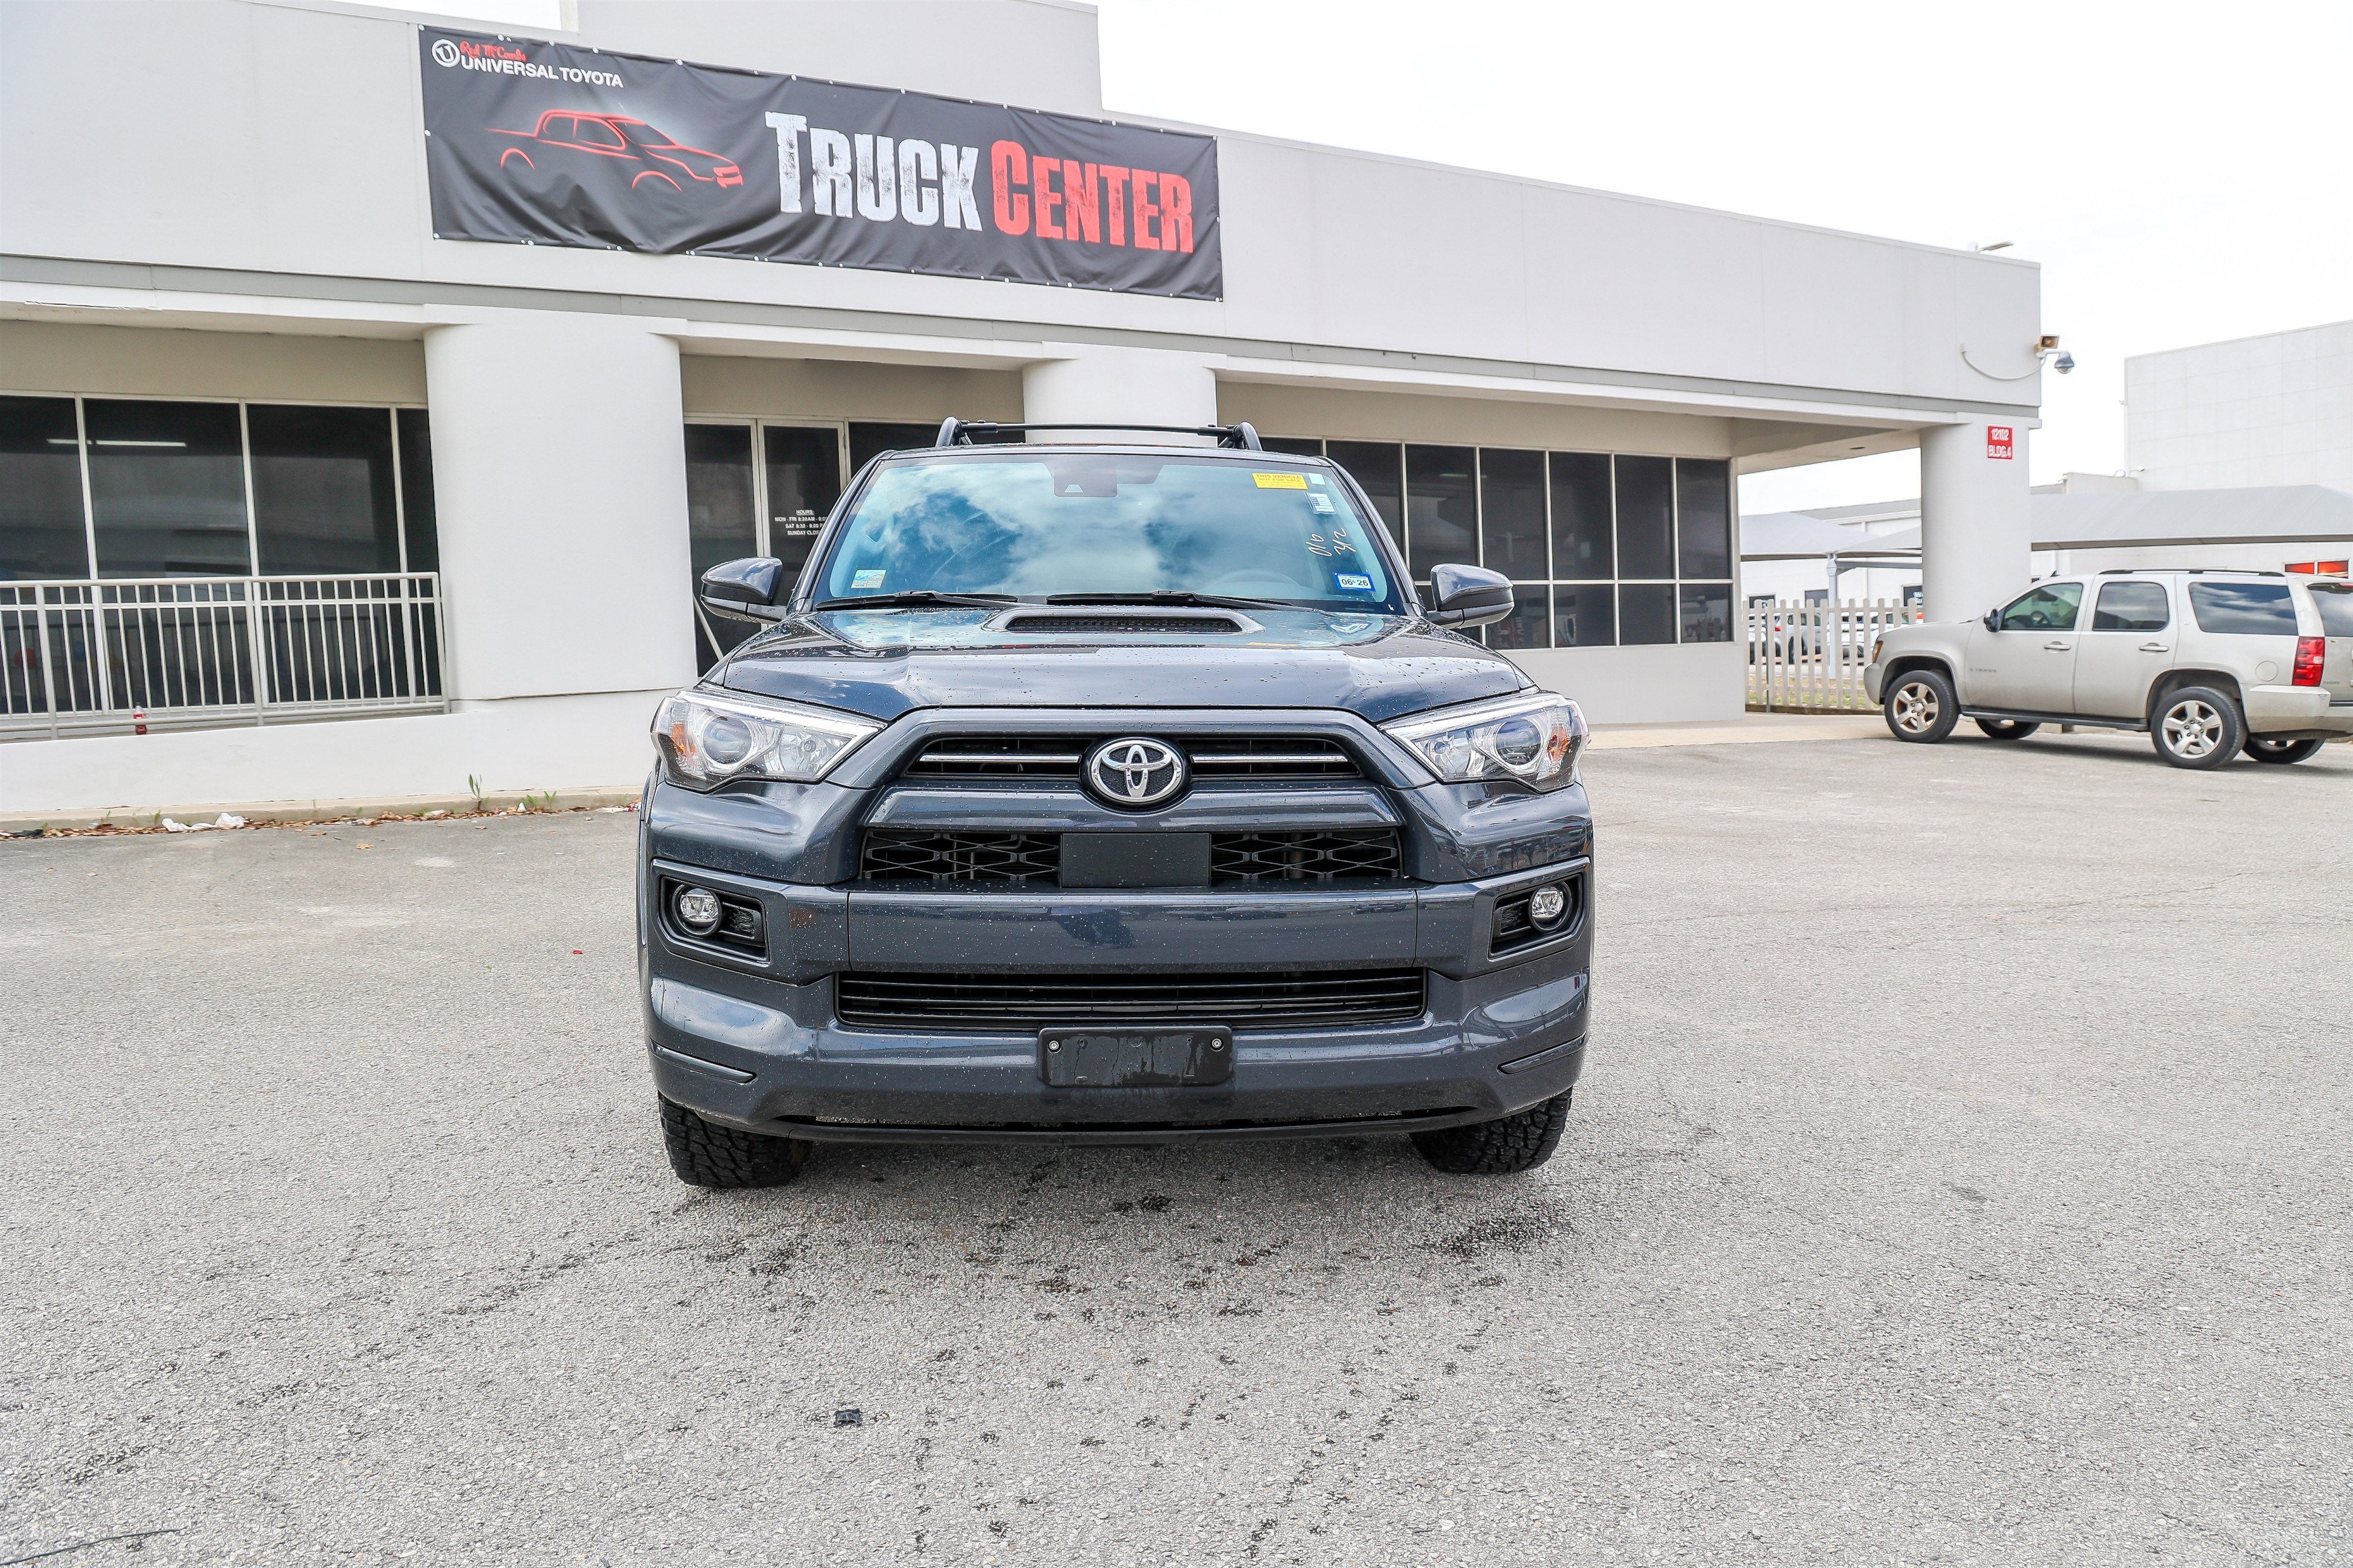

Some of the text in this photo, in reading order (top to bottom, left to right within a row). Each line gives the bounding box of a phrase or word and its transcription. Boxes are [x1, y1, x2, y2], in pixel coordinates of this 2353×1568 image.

[460, 41, 481, 59] Red
[461, 55, 624, 88] UNIVERSAL TOYOTA
[765, 111, 1194, 253] TRUCK CENTER
